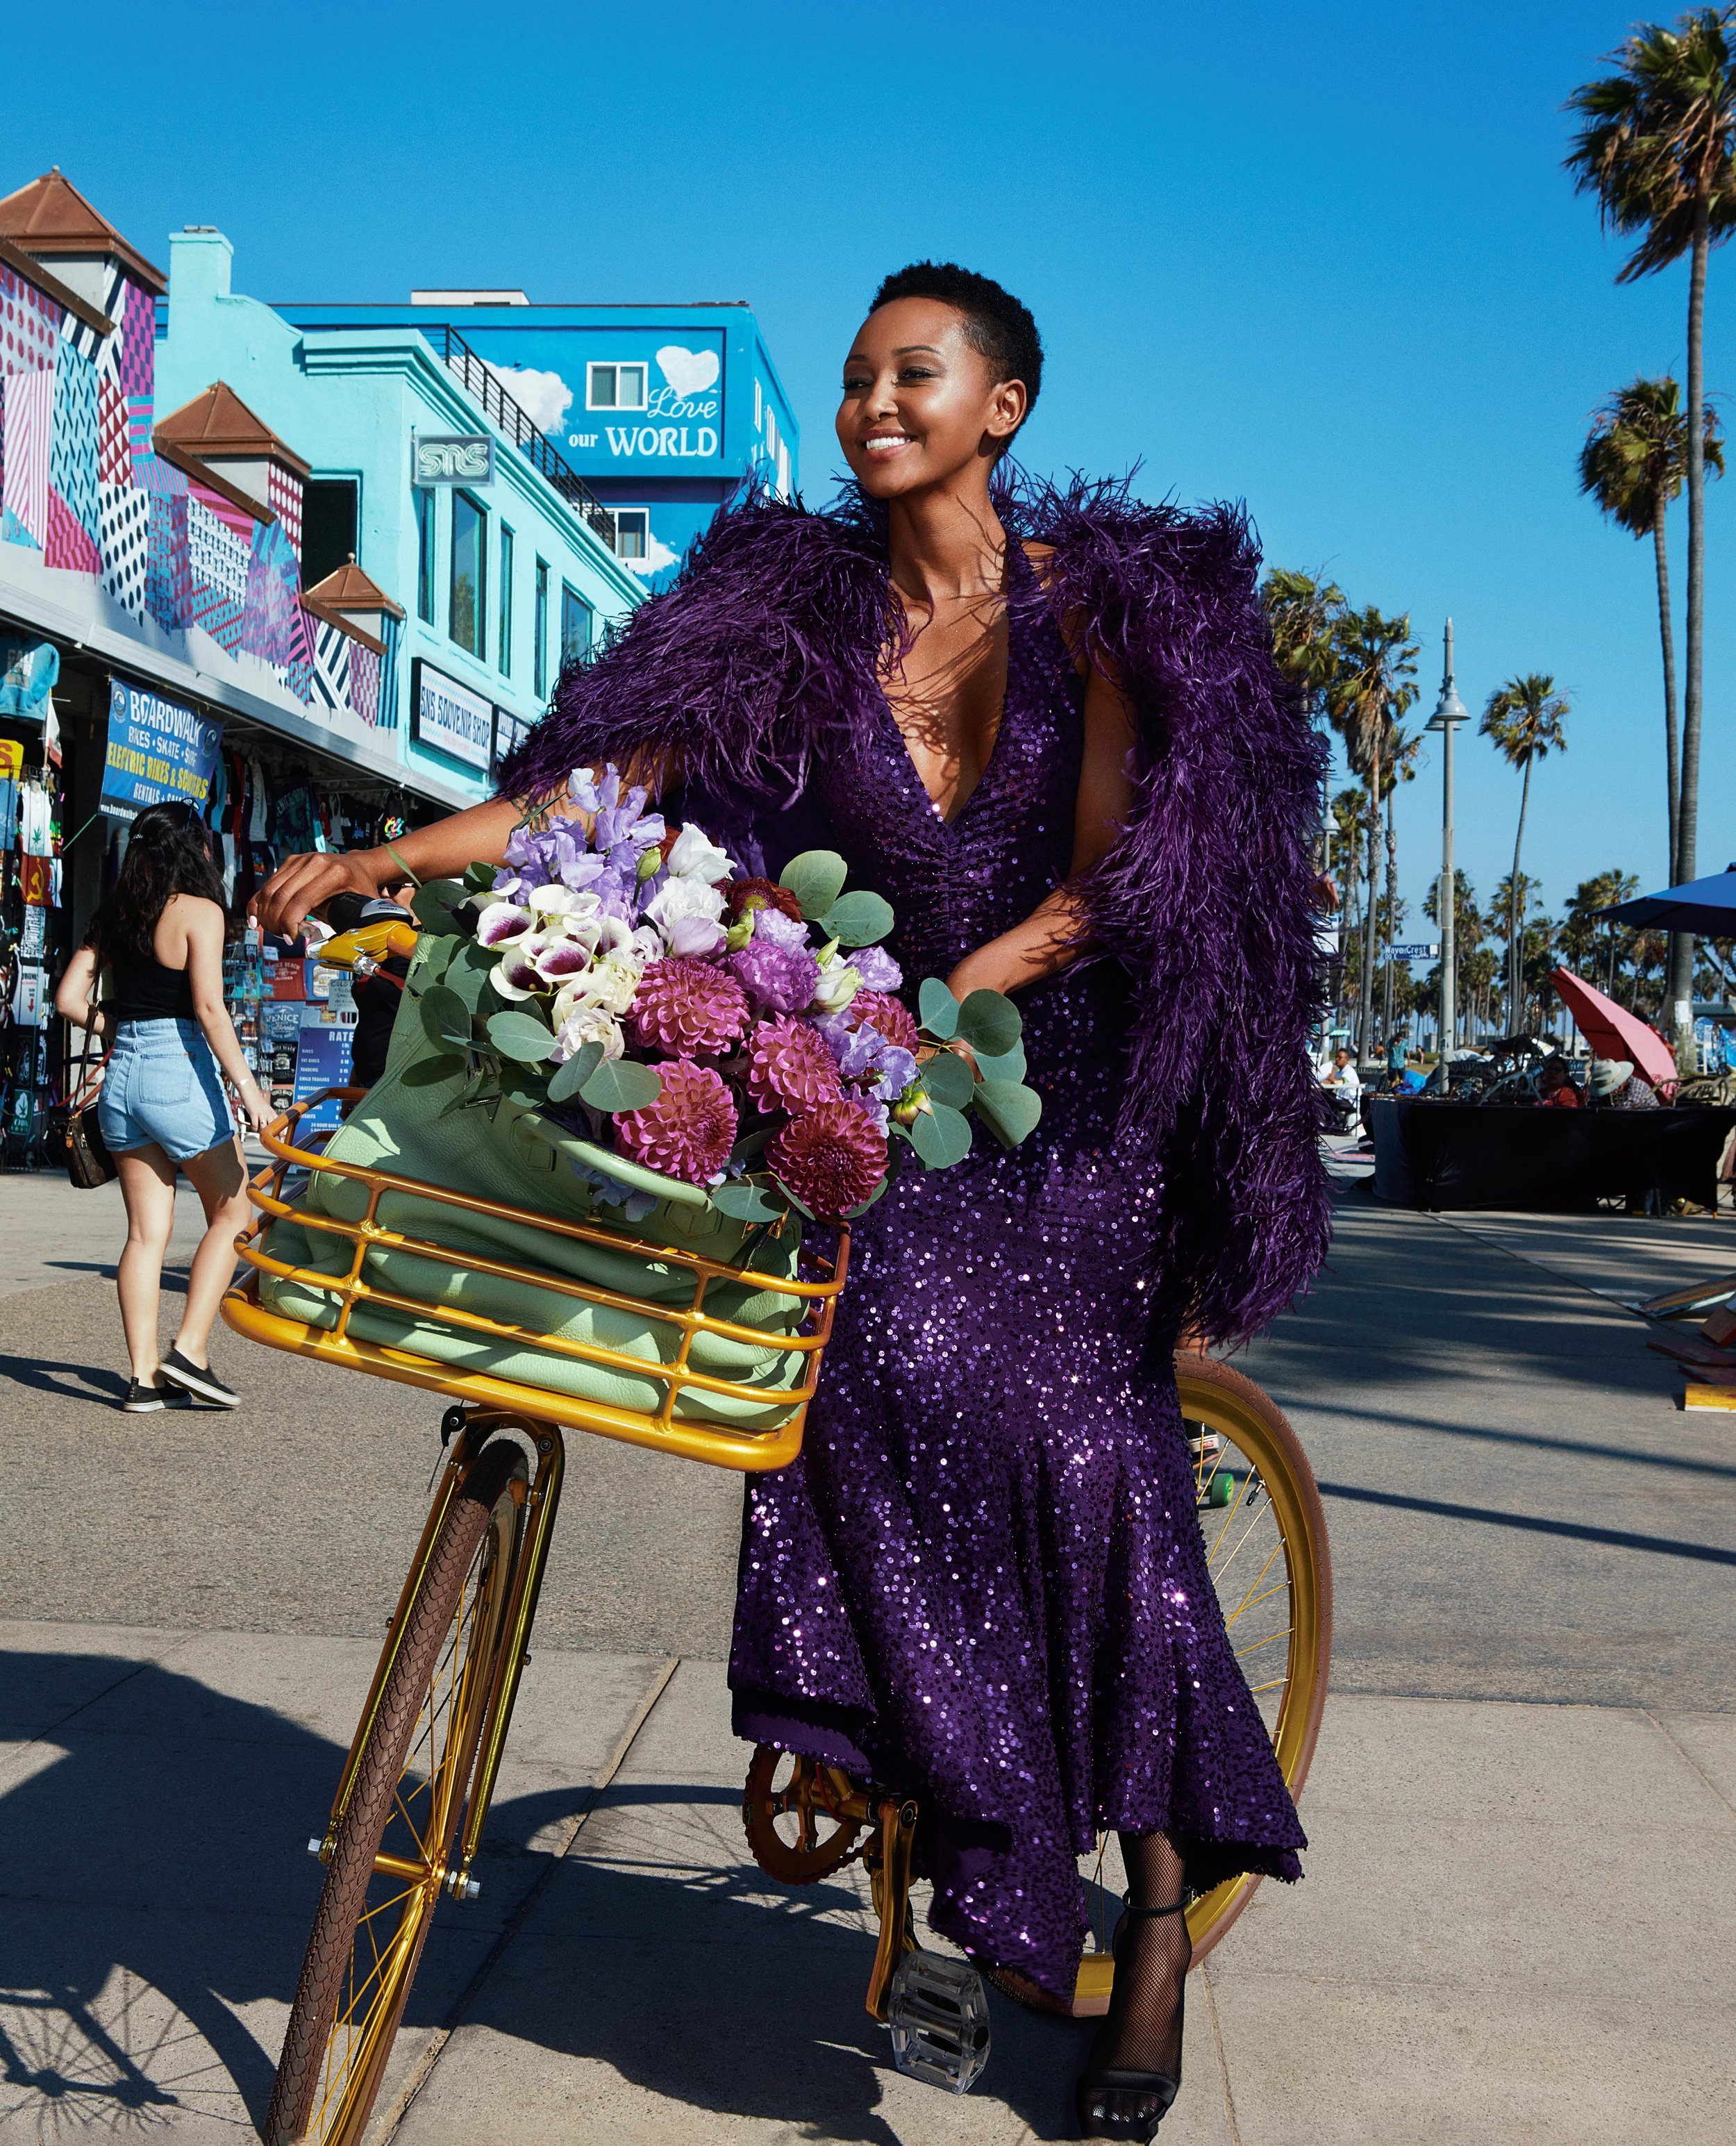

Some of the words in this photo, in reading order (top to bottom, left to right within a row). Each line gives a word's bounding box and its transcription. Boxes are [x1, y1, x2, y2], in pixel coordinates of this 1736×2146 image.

[647, 386, 718, 419] Love
[569, 433, 599, 447] our
[605, 426, 717, 457] WORLD
[130, 690, 205, 747] BOARDWALK
[420, 685, 435, 722] SNS
[437, 694, 471, 741] SOUVENIR
[473, 715, 490, 749] SHOP
[156, 735, 181, 760] SKATE
[107, 742, 146, 777] ELECTRIC
[147, 755, 170, 785] BIKES
[169, 767, 176, 788] &
[133, 782, 160, 805] RENTALS
[1385, 945, 1403, 954] Wave
[1406, 945, 1426, 954] Crest
[266, 1014, 299, 1024] VENICE
[328, 1031, 355, 1042] RATE
